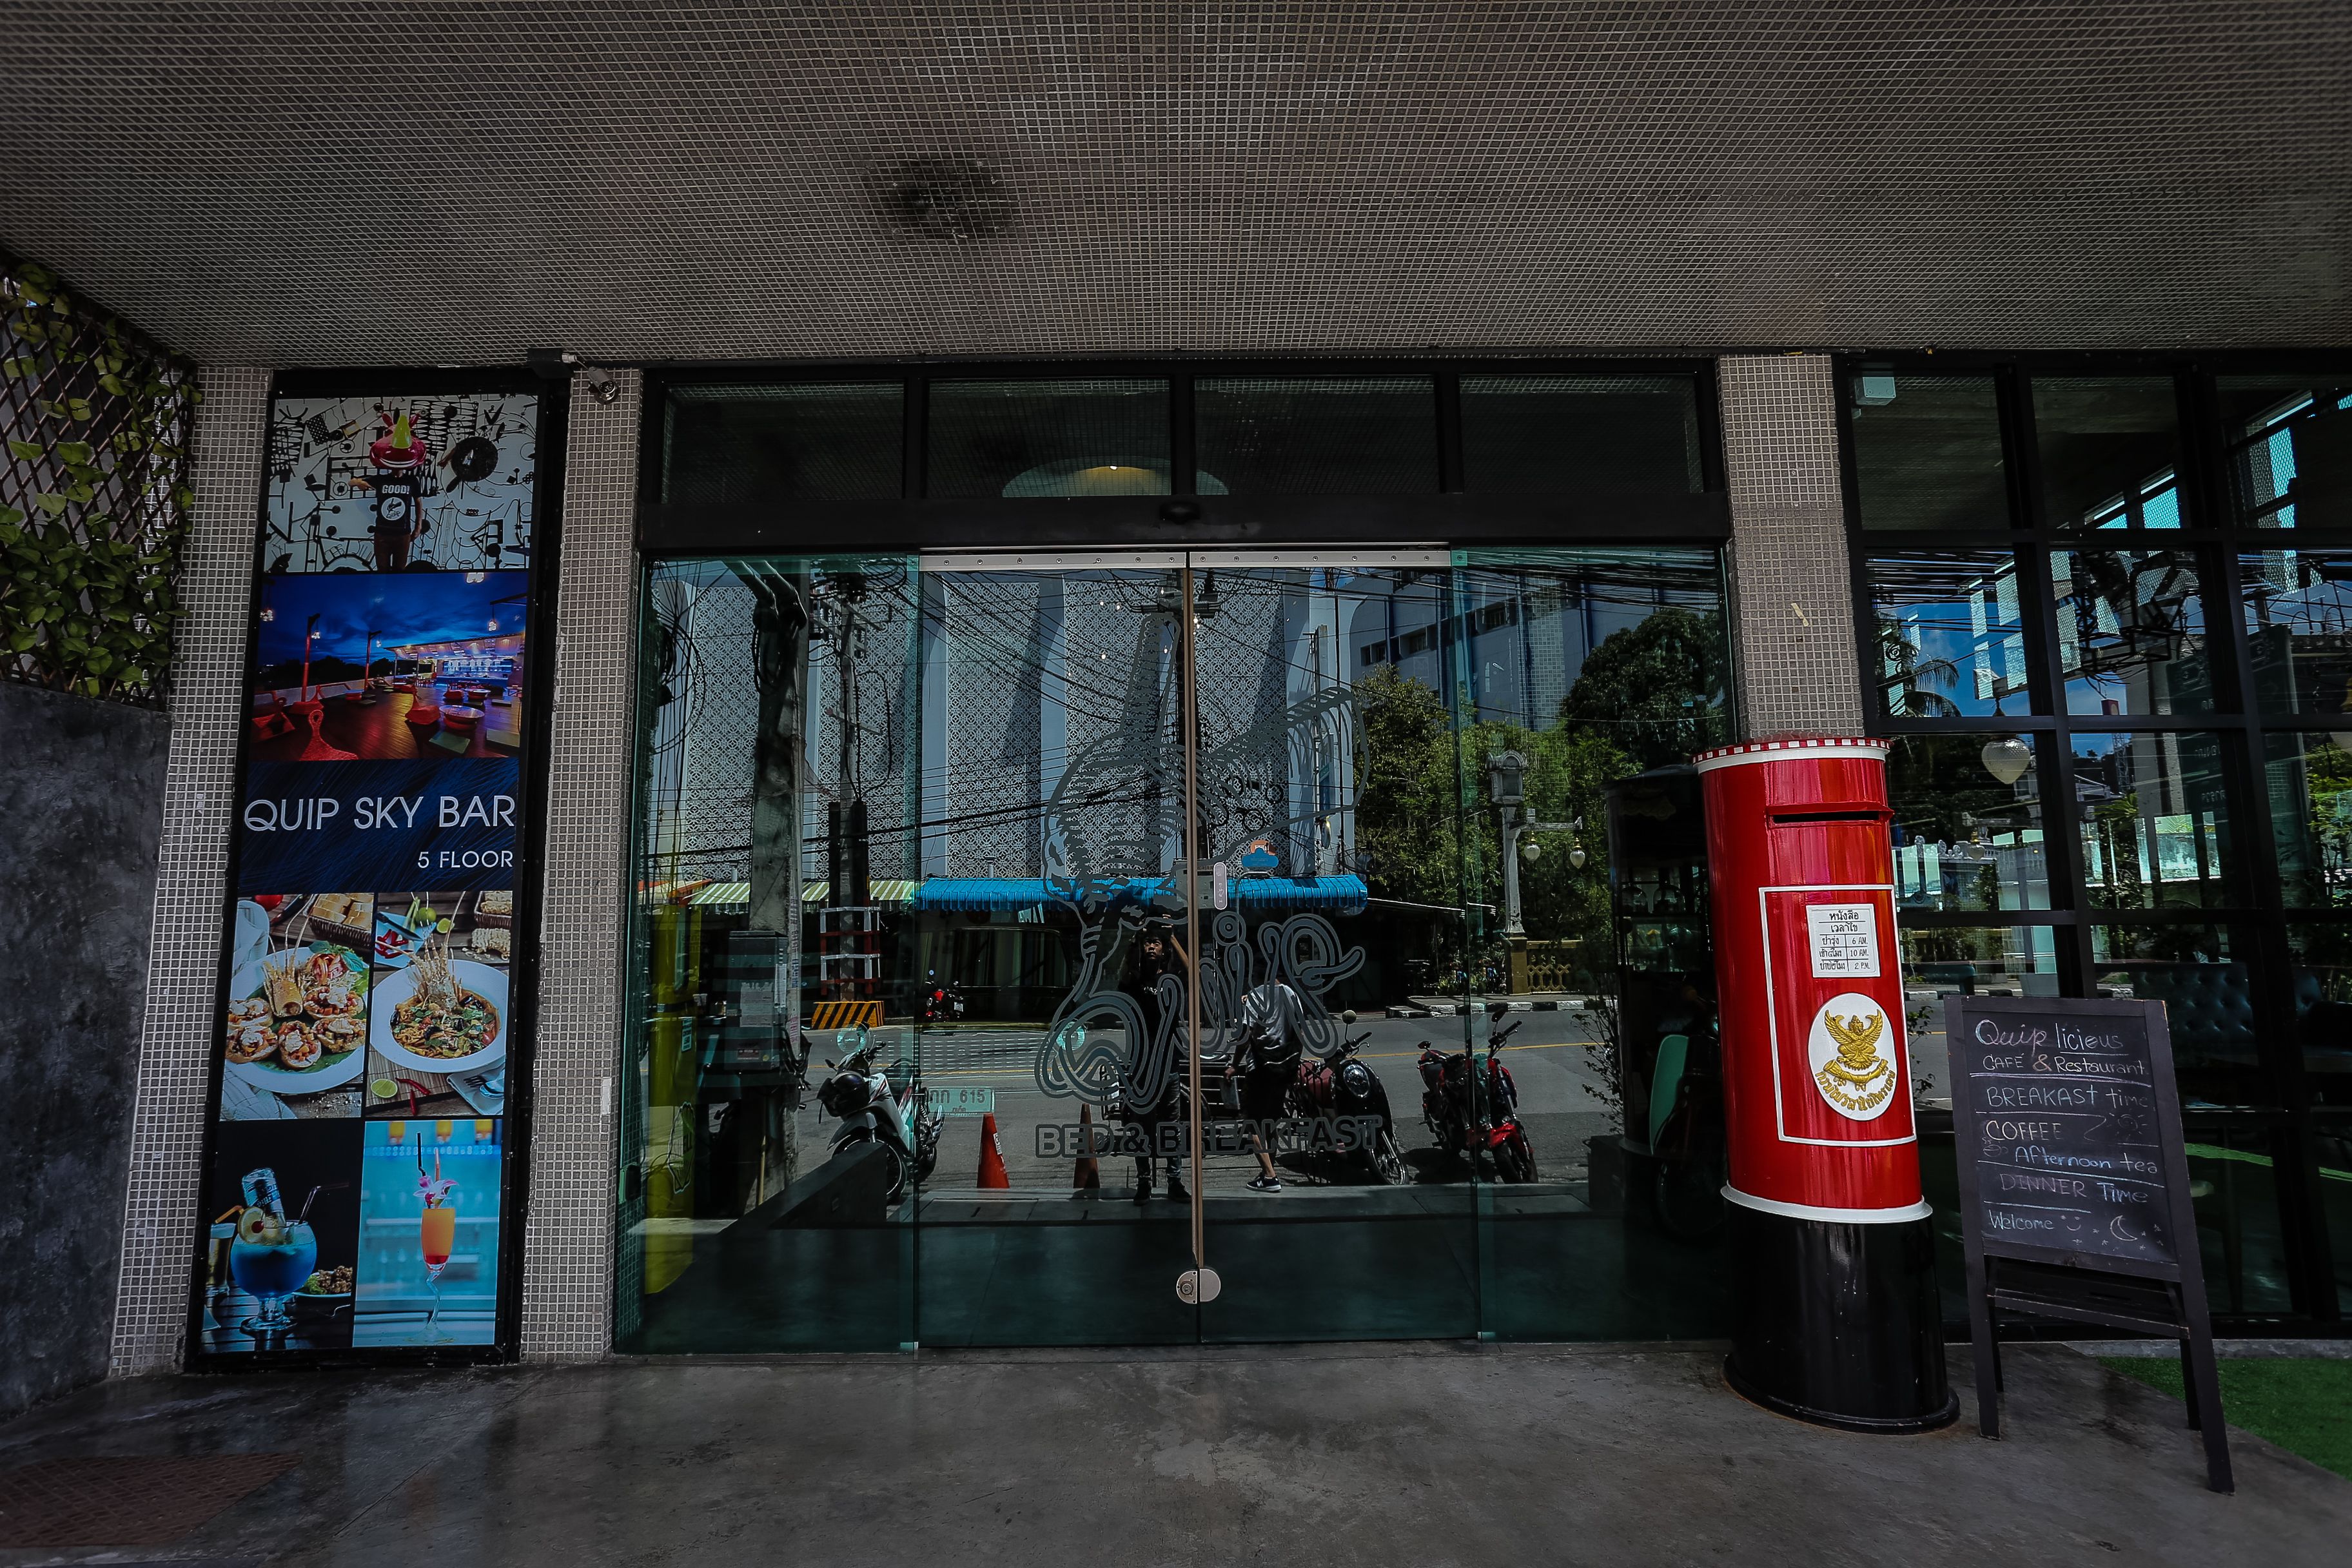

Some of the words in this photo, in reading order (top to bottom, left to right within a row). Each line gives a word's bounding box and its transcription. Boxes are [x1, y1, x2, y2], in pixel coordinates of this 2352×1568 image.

[382, 485, 410, 495] GOOD!
[244, 798, 339, 831] QUIP
[353, 796, 424, 829] SKY
[438, 795, 515, 827] BAR
[417, 851, 430, 868] 5
[440, 850, 513, 868] FLOOR
[1829, 910, 1859, 921] หนังสือ
[1975, 1019, 2047, 1057] Quip
[2032, 1054, 2052, 1072] &
[959, 1089, 985, 1104] 615
[1035, 1123, 1119, 1158] BED
[1120, 1122, 1151, 1157] &
[1157, 1115, 1382, 1157] BREAKFAST
[1986, 1120, 2062, 1141] COFFEE
[2119, 1152, 2158, 1174] tea
[1999, 1173, 2087, 1197] DINNER
[1988, 1209, 2055, 1231] Welcome
